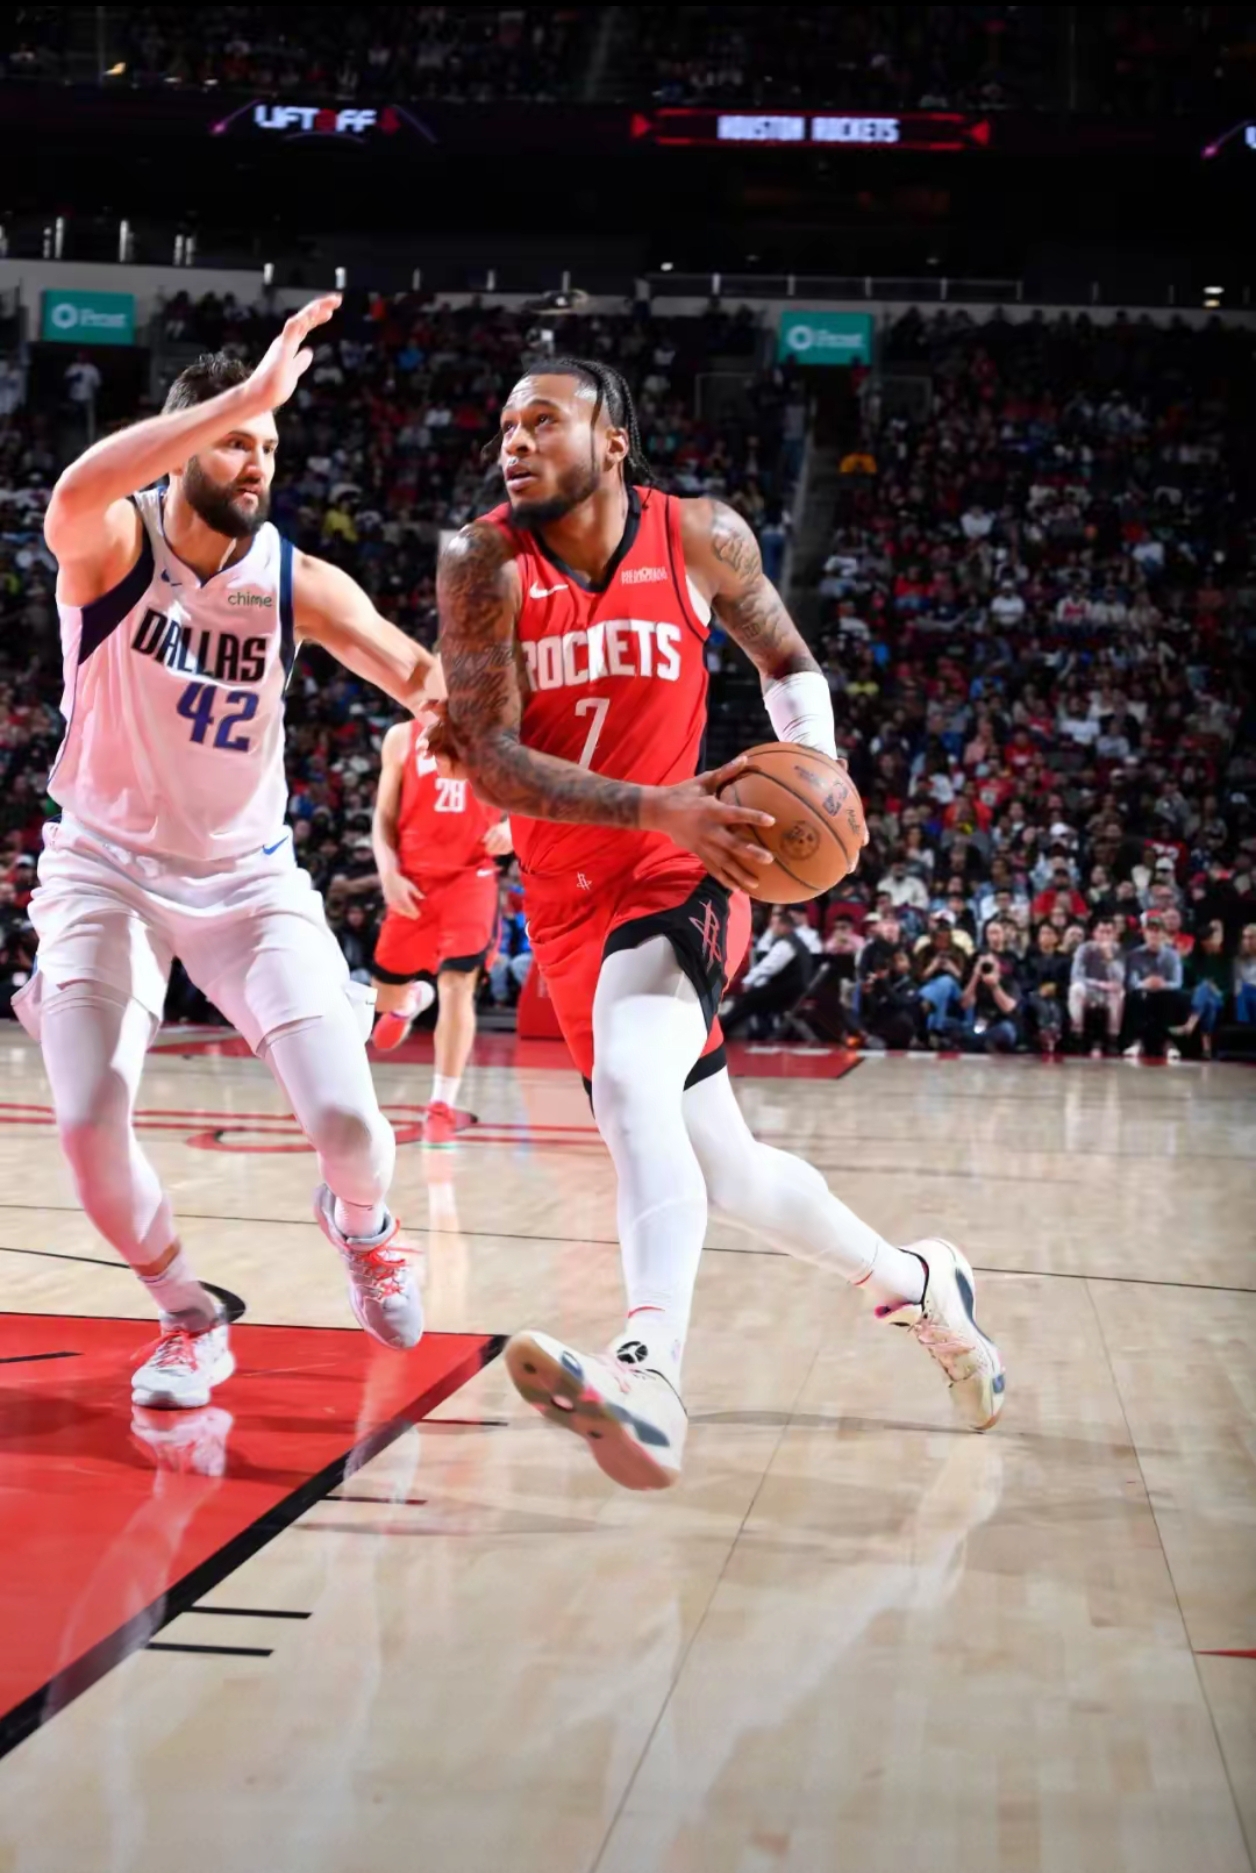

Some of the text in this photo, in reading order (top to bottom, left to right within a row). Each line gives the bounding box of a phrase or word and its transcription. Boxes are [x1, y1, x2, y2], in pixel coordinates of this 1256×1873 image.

[228, 592, 273, 607] chime
[131, 607, 267, 683] DALLAS
[176, 681, 260, 753] 42
[575, 697, 610, 770] 7
[433, 777, 466, 813] 28
